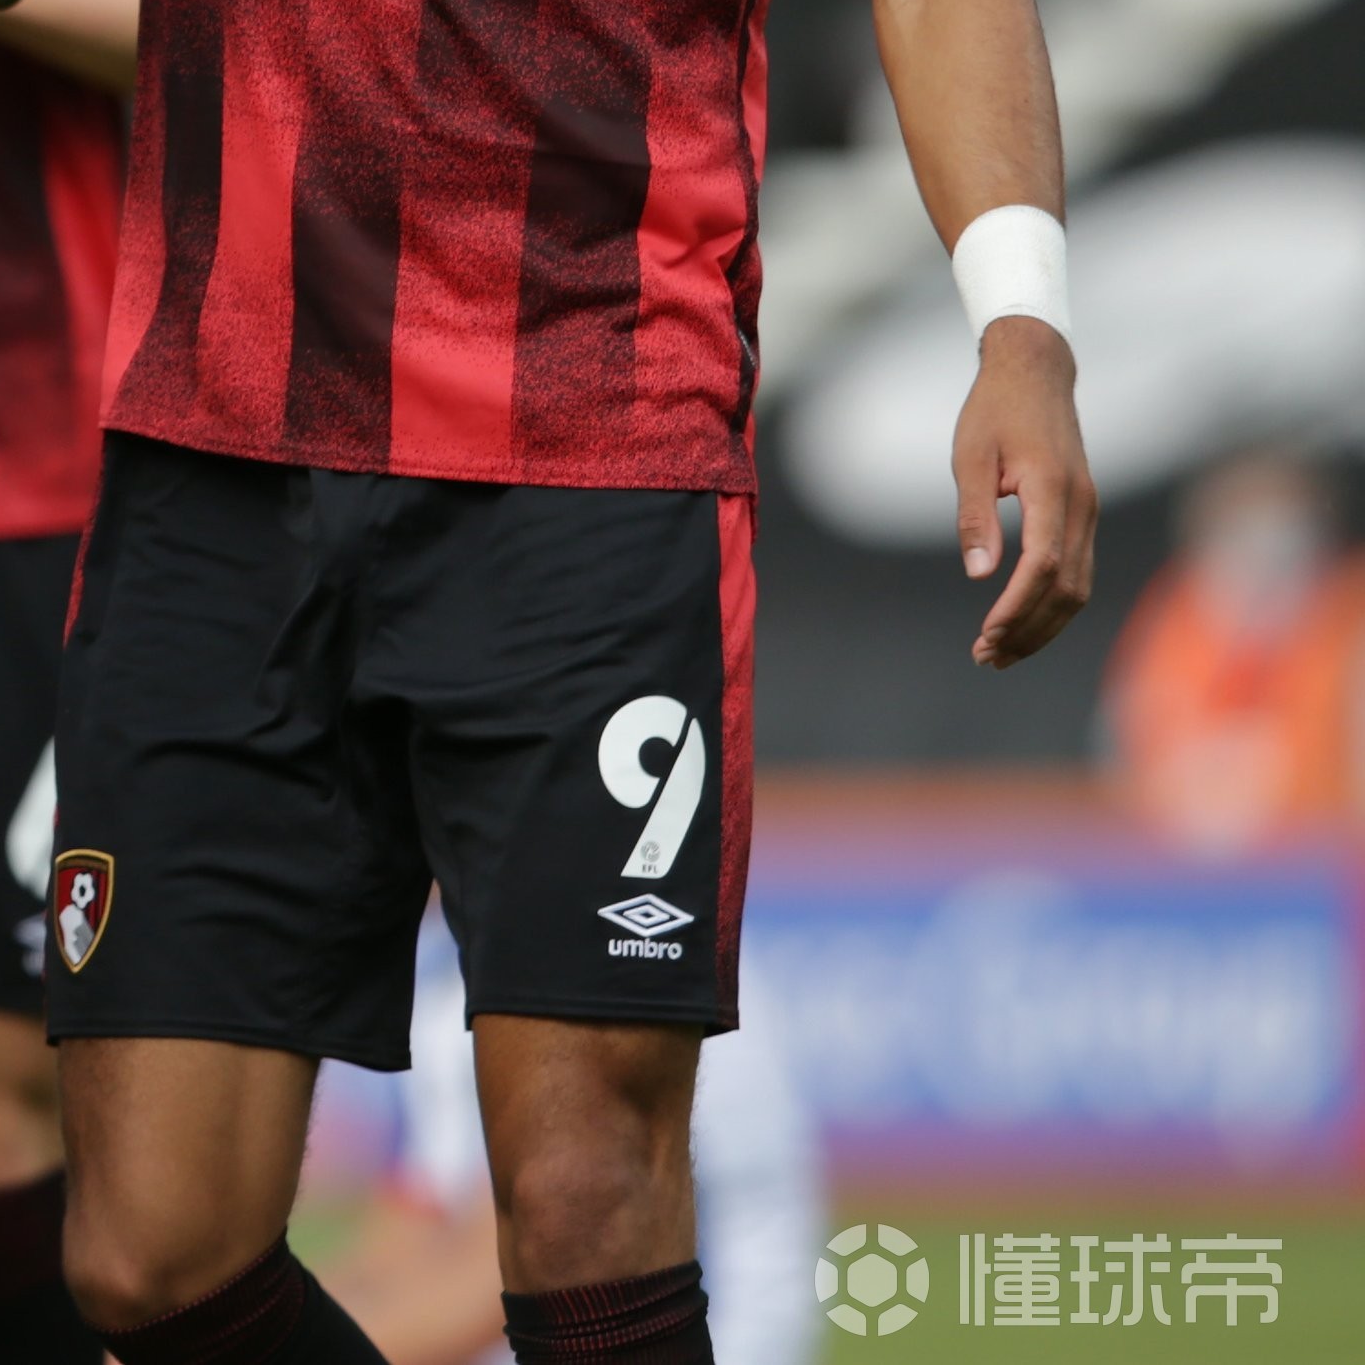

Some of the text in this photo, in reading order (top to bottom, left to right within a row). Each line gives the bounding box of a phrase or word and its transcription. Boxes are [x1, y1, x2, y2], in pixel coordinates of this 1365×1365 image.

[597, 694, 706, 880] 9
[642, 863, 659, 875] EFL
[607, 938, 683, 960] umbro
